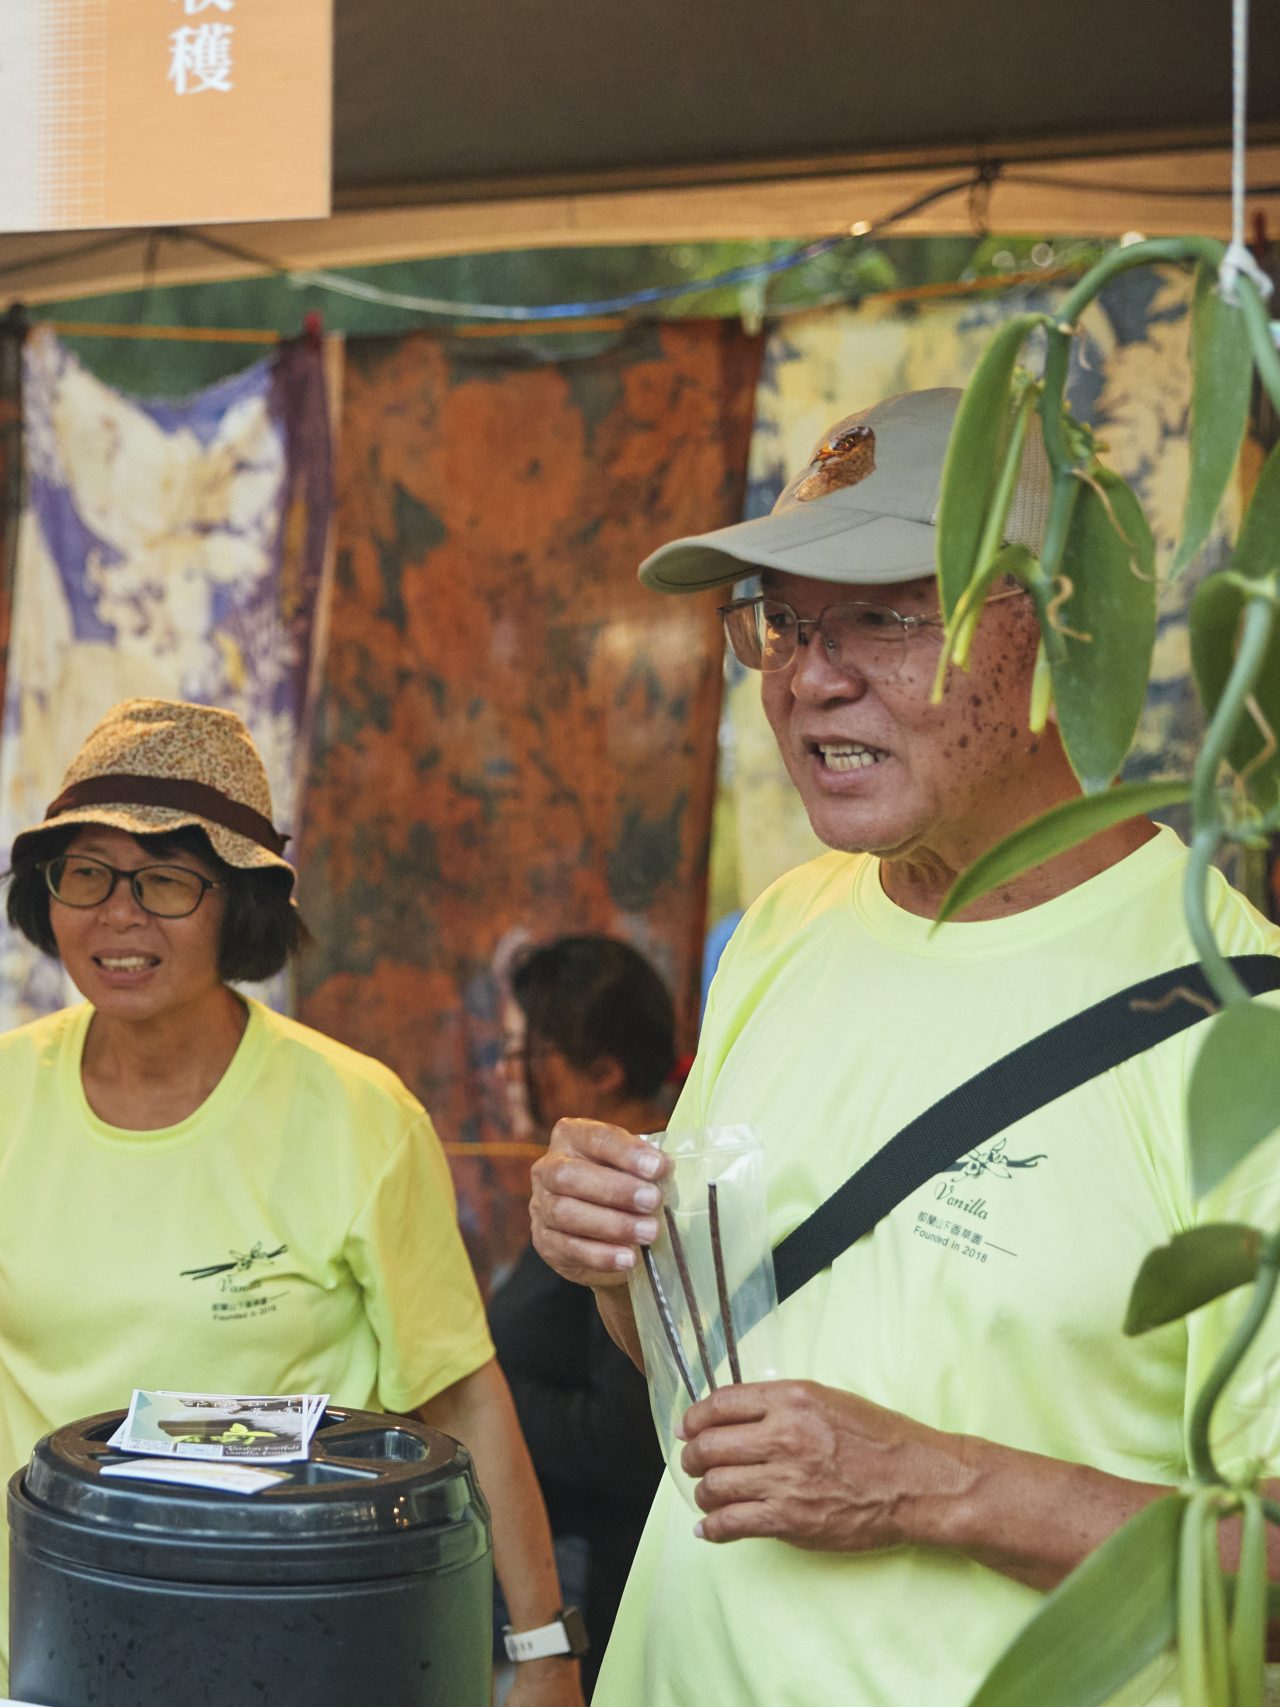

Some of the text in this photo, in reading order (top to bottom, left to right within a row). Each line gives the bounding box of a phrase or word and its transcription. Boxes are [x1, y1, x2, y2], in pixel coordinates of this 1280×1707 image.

[167, 0, 234, 95] 穫
[934, 1181, 989, 1220] Vanilla
[913, 1225, 989, 1264] Founded in 2018
